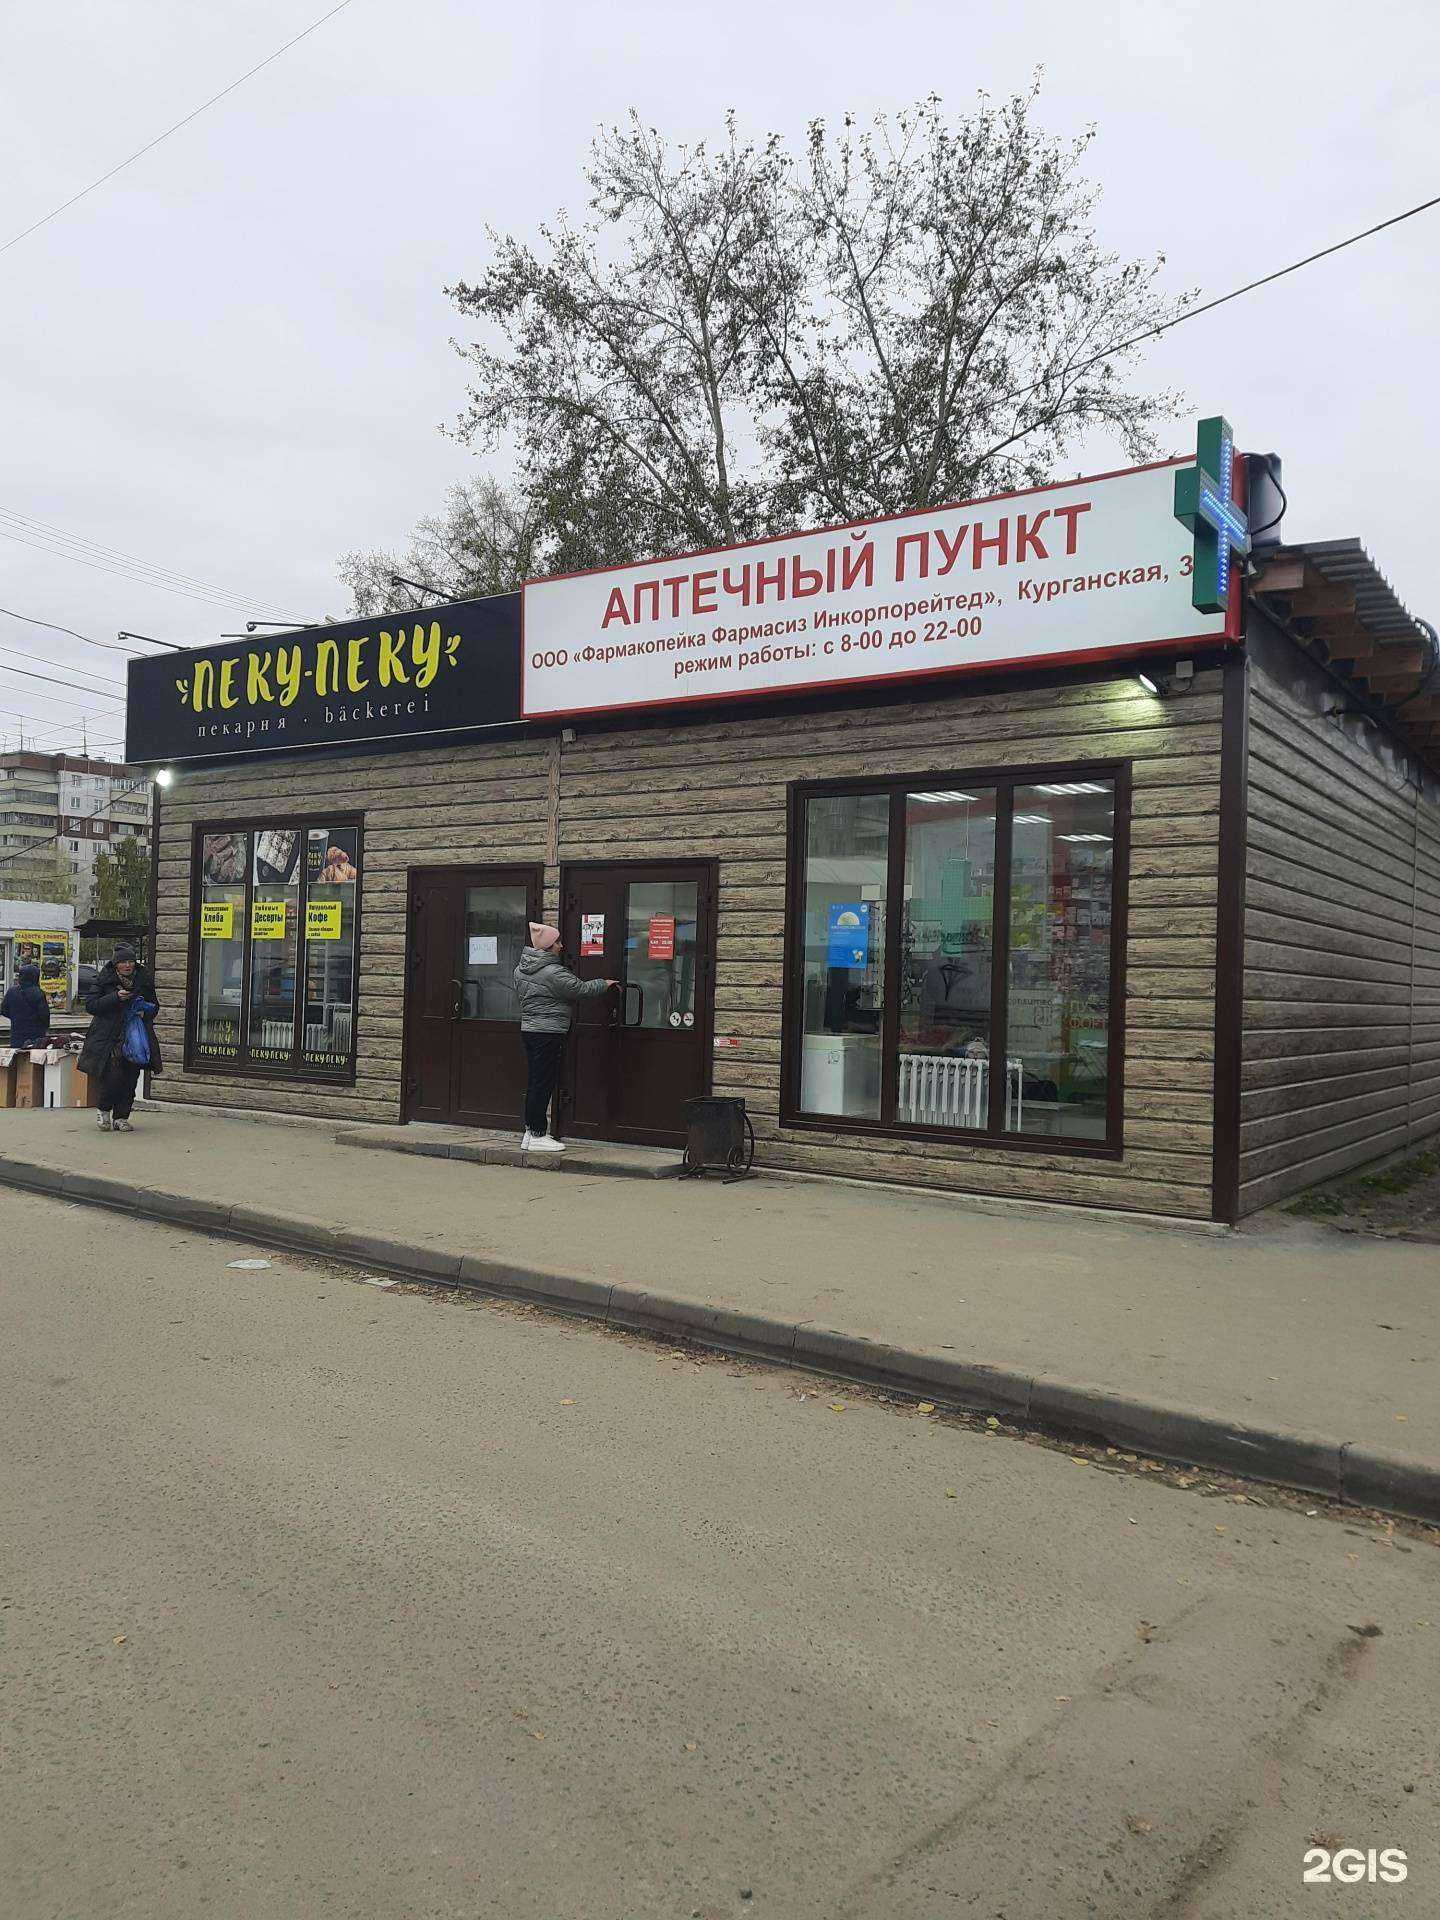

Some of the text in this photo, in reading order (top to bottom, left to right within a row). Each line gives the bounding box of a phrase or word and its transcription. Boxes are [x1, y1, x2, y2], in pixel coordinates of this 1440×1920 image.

[601, 502, 1092, 629] АПТЕЧНЫЙ ПУНКТ
[532, 649, 568, 669] ООО
[573, 631, 706, 664] «Фармакопейка
[712, 617, 807, 648] Фармасиз
[814, 590, 1002, 626] Инкорпорейтед»,
[1018, 563, 1169, 603] Курганская,
[193, 621, 441, 712] ПЕКУ-ПЕКУ
[674, 616, 982, 679] режим работы: с 8-00 до 22-00
[198, 717, 286, 738] пекарня
[325, 693, 430, 723] bäckerei
[254, 912, 284, 924] Десерты
[308, 912, 328, 923] Кофе
